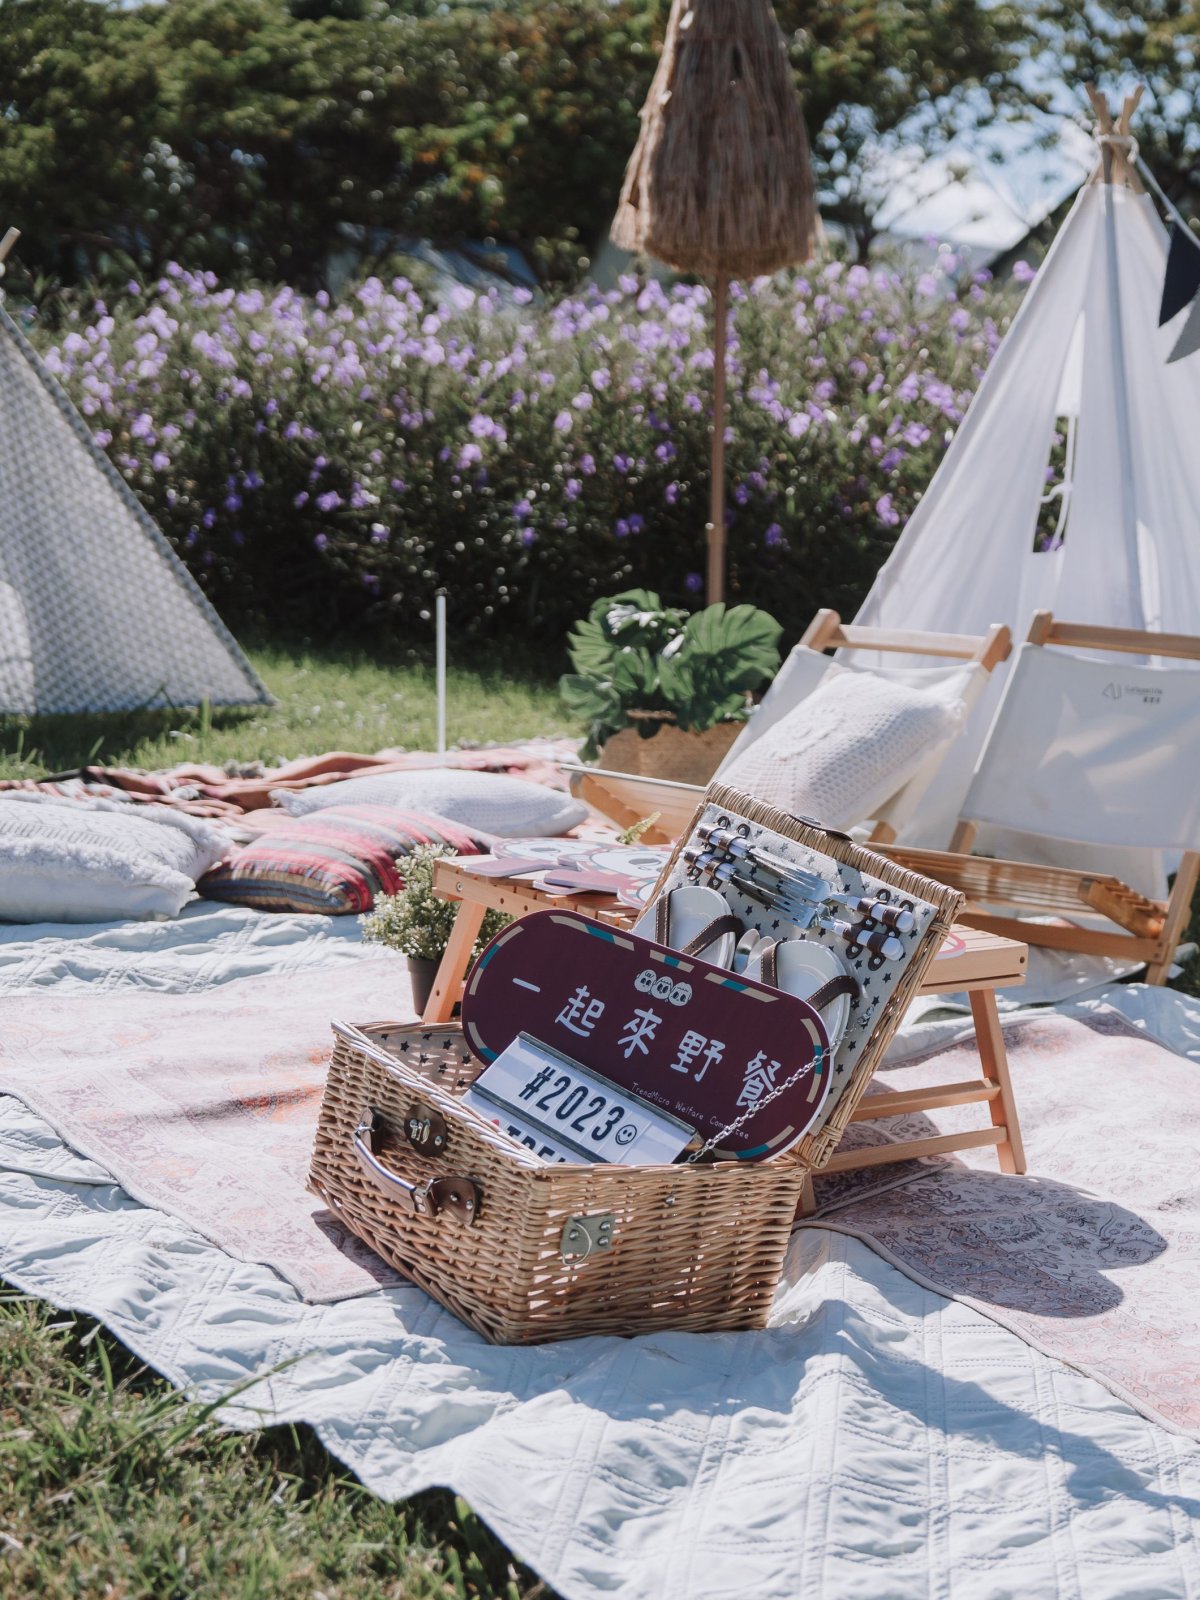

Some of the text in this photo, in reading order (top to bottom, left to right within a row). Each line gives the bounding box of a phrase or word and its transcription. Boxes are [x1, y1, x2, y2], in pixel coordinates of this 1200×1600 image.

[512, 977, 781, 1110] 一起來野餐
[518, 1066, 625, 1141] #2023
[631, 1081, 749, 1139] TrendMicro Welfare Comtee
